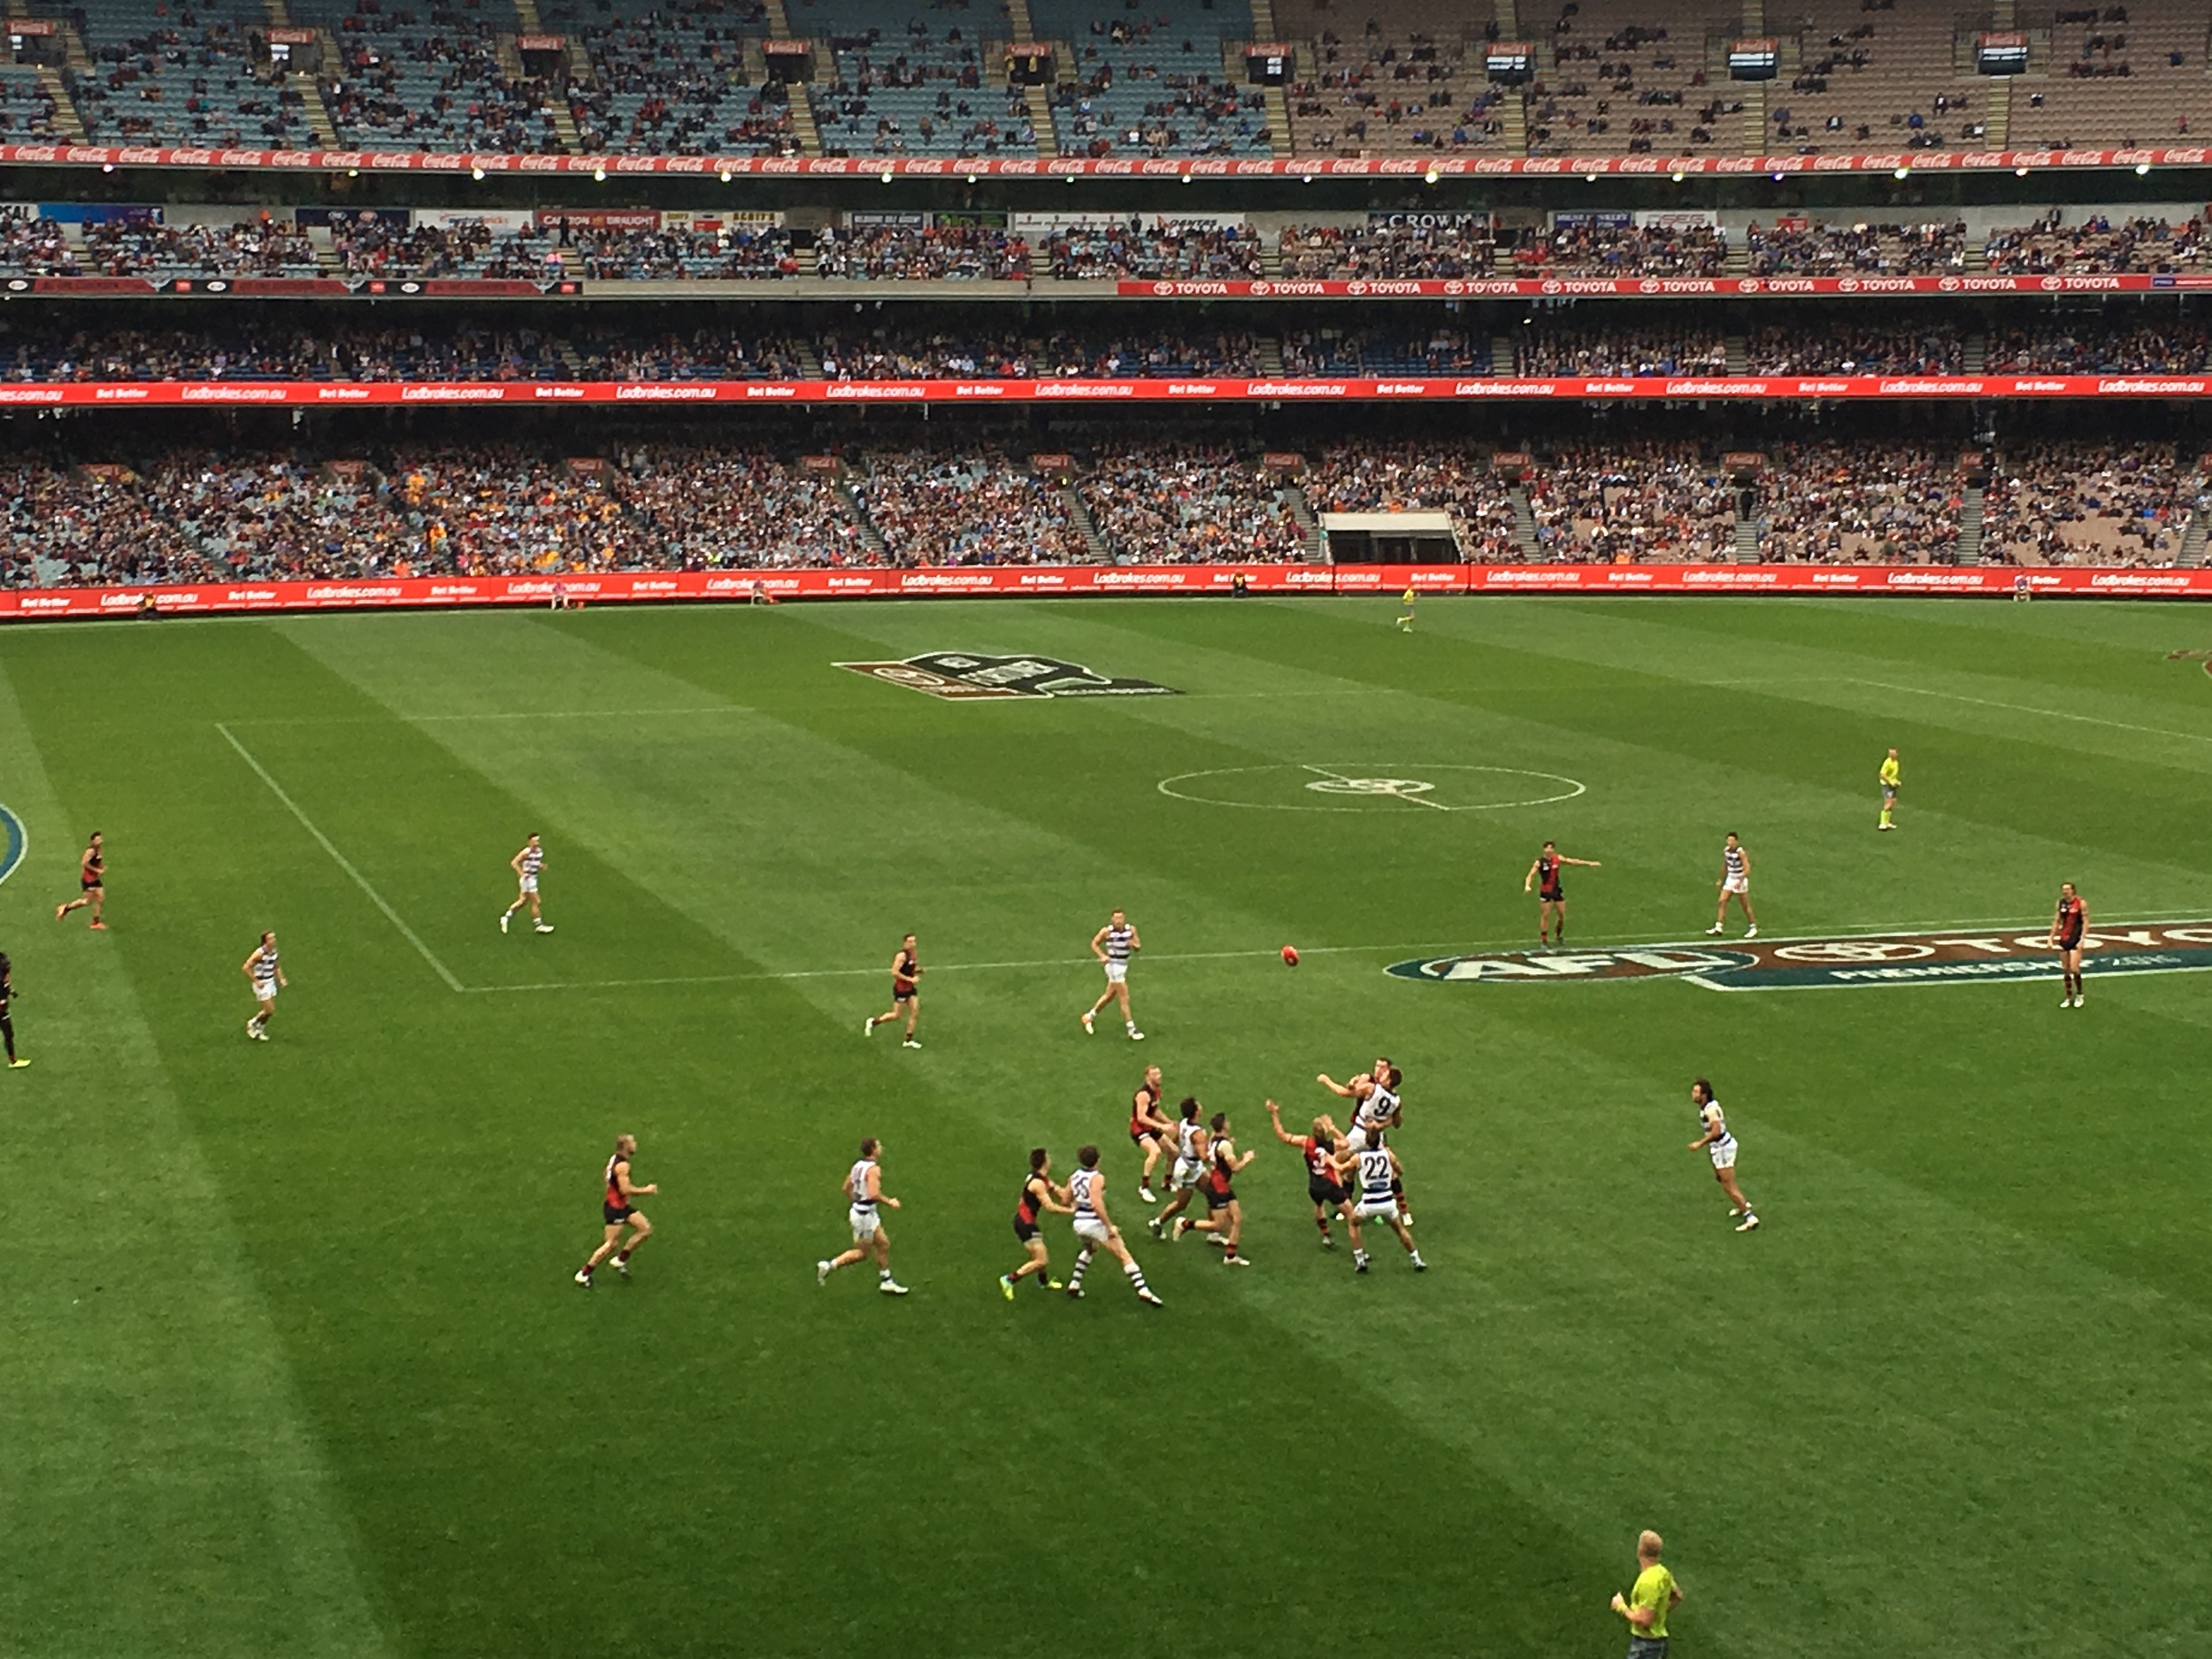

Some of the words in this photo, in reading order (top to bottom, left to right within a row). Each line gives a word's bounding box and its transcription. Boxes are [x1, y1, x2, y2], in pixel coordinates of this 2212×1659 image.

[1389, 214, 1466, 228] CROWN
[1176, 283, 1227, 294] TOYOTA
[1272, 283, 1325, 294] TOYOTA
[1370, 281, 1421, 293] TOYOTA
[1564, 280, 1617, 292] TOYOTA
[1663, 280, 1715, 291] TOYOTA
[1862, 279, 1915, 289] TOYOTA
[1962, 277, 2016, 288] TOYOTA
[2065, 276, 2120, 288] TOYOTA
[182, 388, 287, 399] Ladbrokes.com.au
[402, 388, 504, 399] Ladbrokes.com.au
[616, 387, 717, 398] Ladbrokes.com.au
[826, 386, 926, 397] Ladbrokes.com.au
[1035, 384, 1133, 396] Ladbrokes.com.au
[1248, 383, 1346, 395] Ladbrokes.com.au
[1455, 383, 1555, 394] Ladbrokes.com.au
[1666, 382, 1766, 394] Ladbrokes.com.au
[1880, 381, 1983, 392] Ladbrokes.com.au
[2099, 380, 2205, 392] Ladbrokes.com.au
[307, 587, 402, 598] Ladbrokes.com.au
[902, 574, 993, 585] Ladbrokes.com.au
[1094, 572, 1185, 583] Ladbrokes.com.au
[1486, 571, 1579, 581] Ladbrokes.com.au
[1682, 572, 1777, 581] Ladbrokes.com.au
[1887, 572, 1984, 584] Ladbrokes.com.au
[2092, 574, 2190, 586] Ladbrokes.com.au
[1442, 952, 1735, 979] AFL
[1374, 1096, 1391, 1117] 9
[1364, 1156, 1389, 1180] 22
